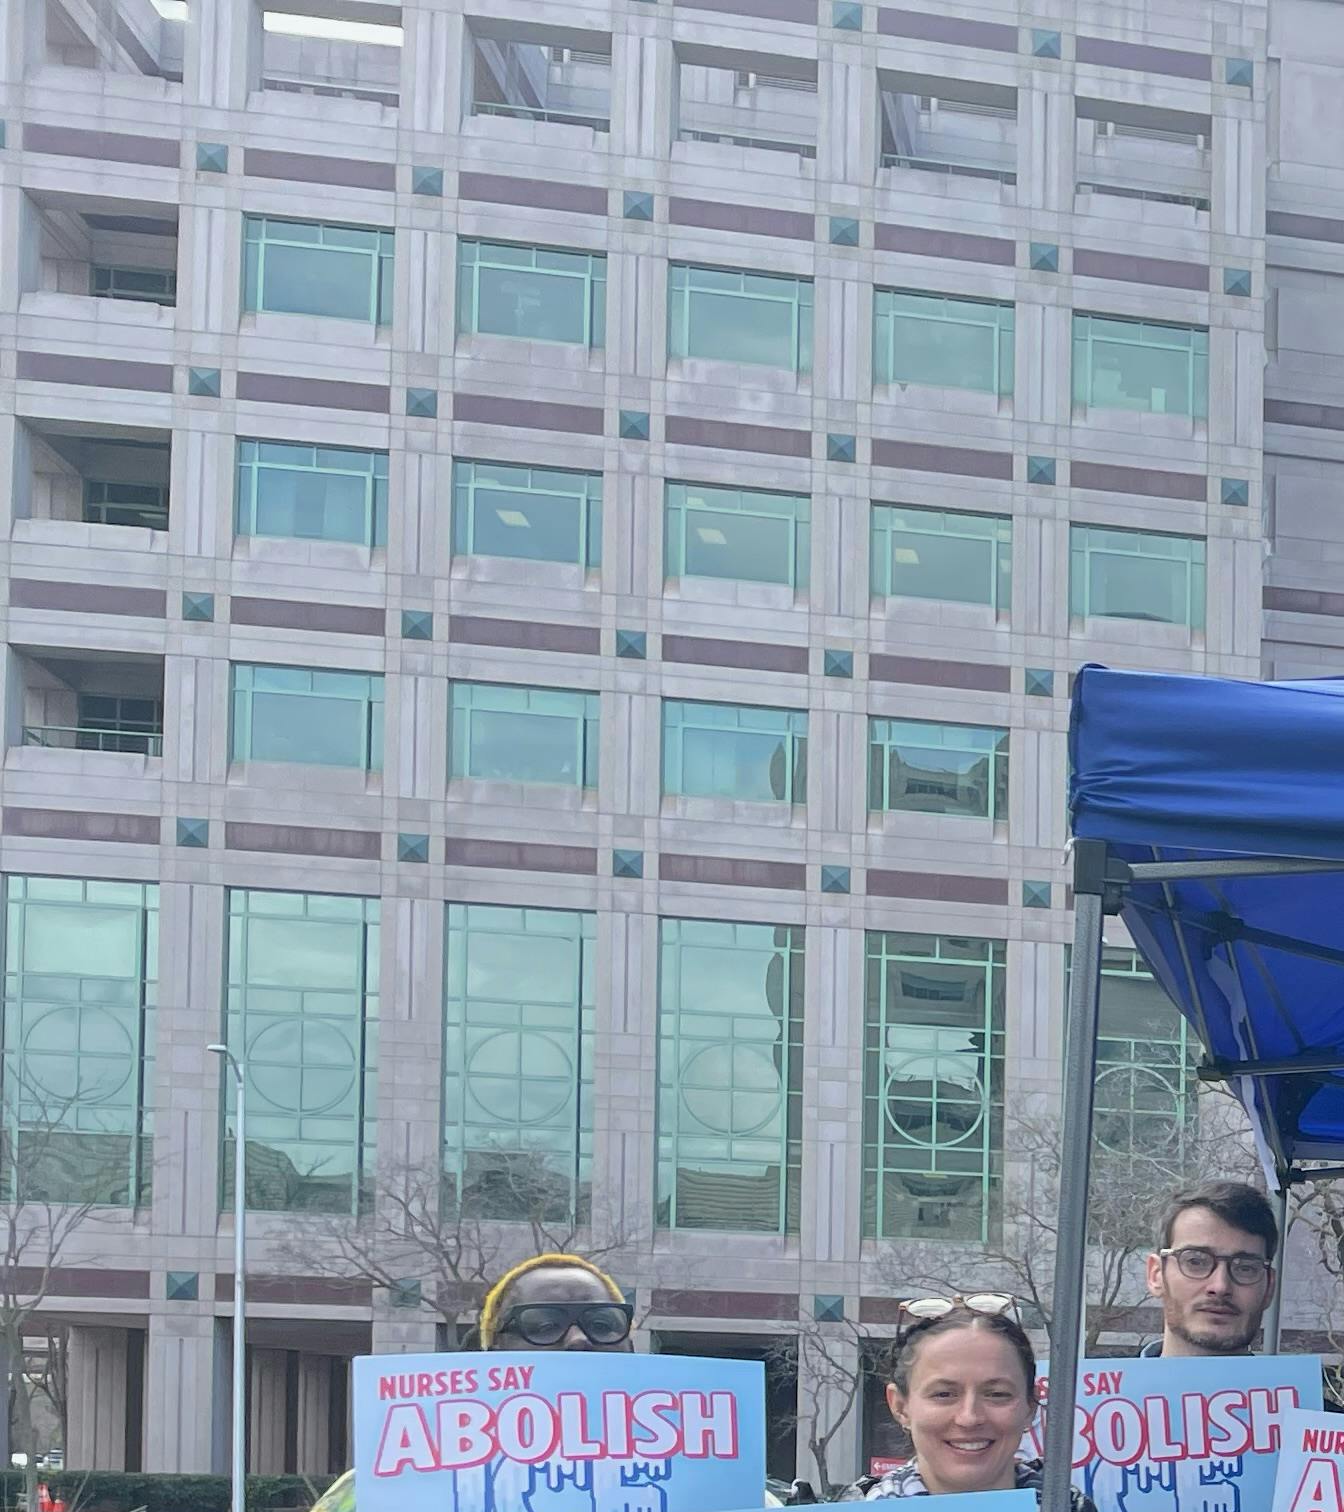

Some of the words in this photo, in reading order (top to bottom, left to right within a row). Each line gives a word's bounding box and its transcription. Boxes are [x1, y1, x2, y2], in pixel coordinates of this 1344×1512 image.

[378, 1369, 479, 1400] NURSES
[488, 1365, 535, 1391] SAY
[1083, 1371, 1124, 1396] SAY
[374, 1390, 739, 1477] ABOLISH
[1014, 1386, 1299, 1468] BOLISH
